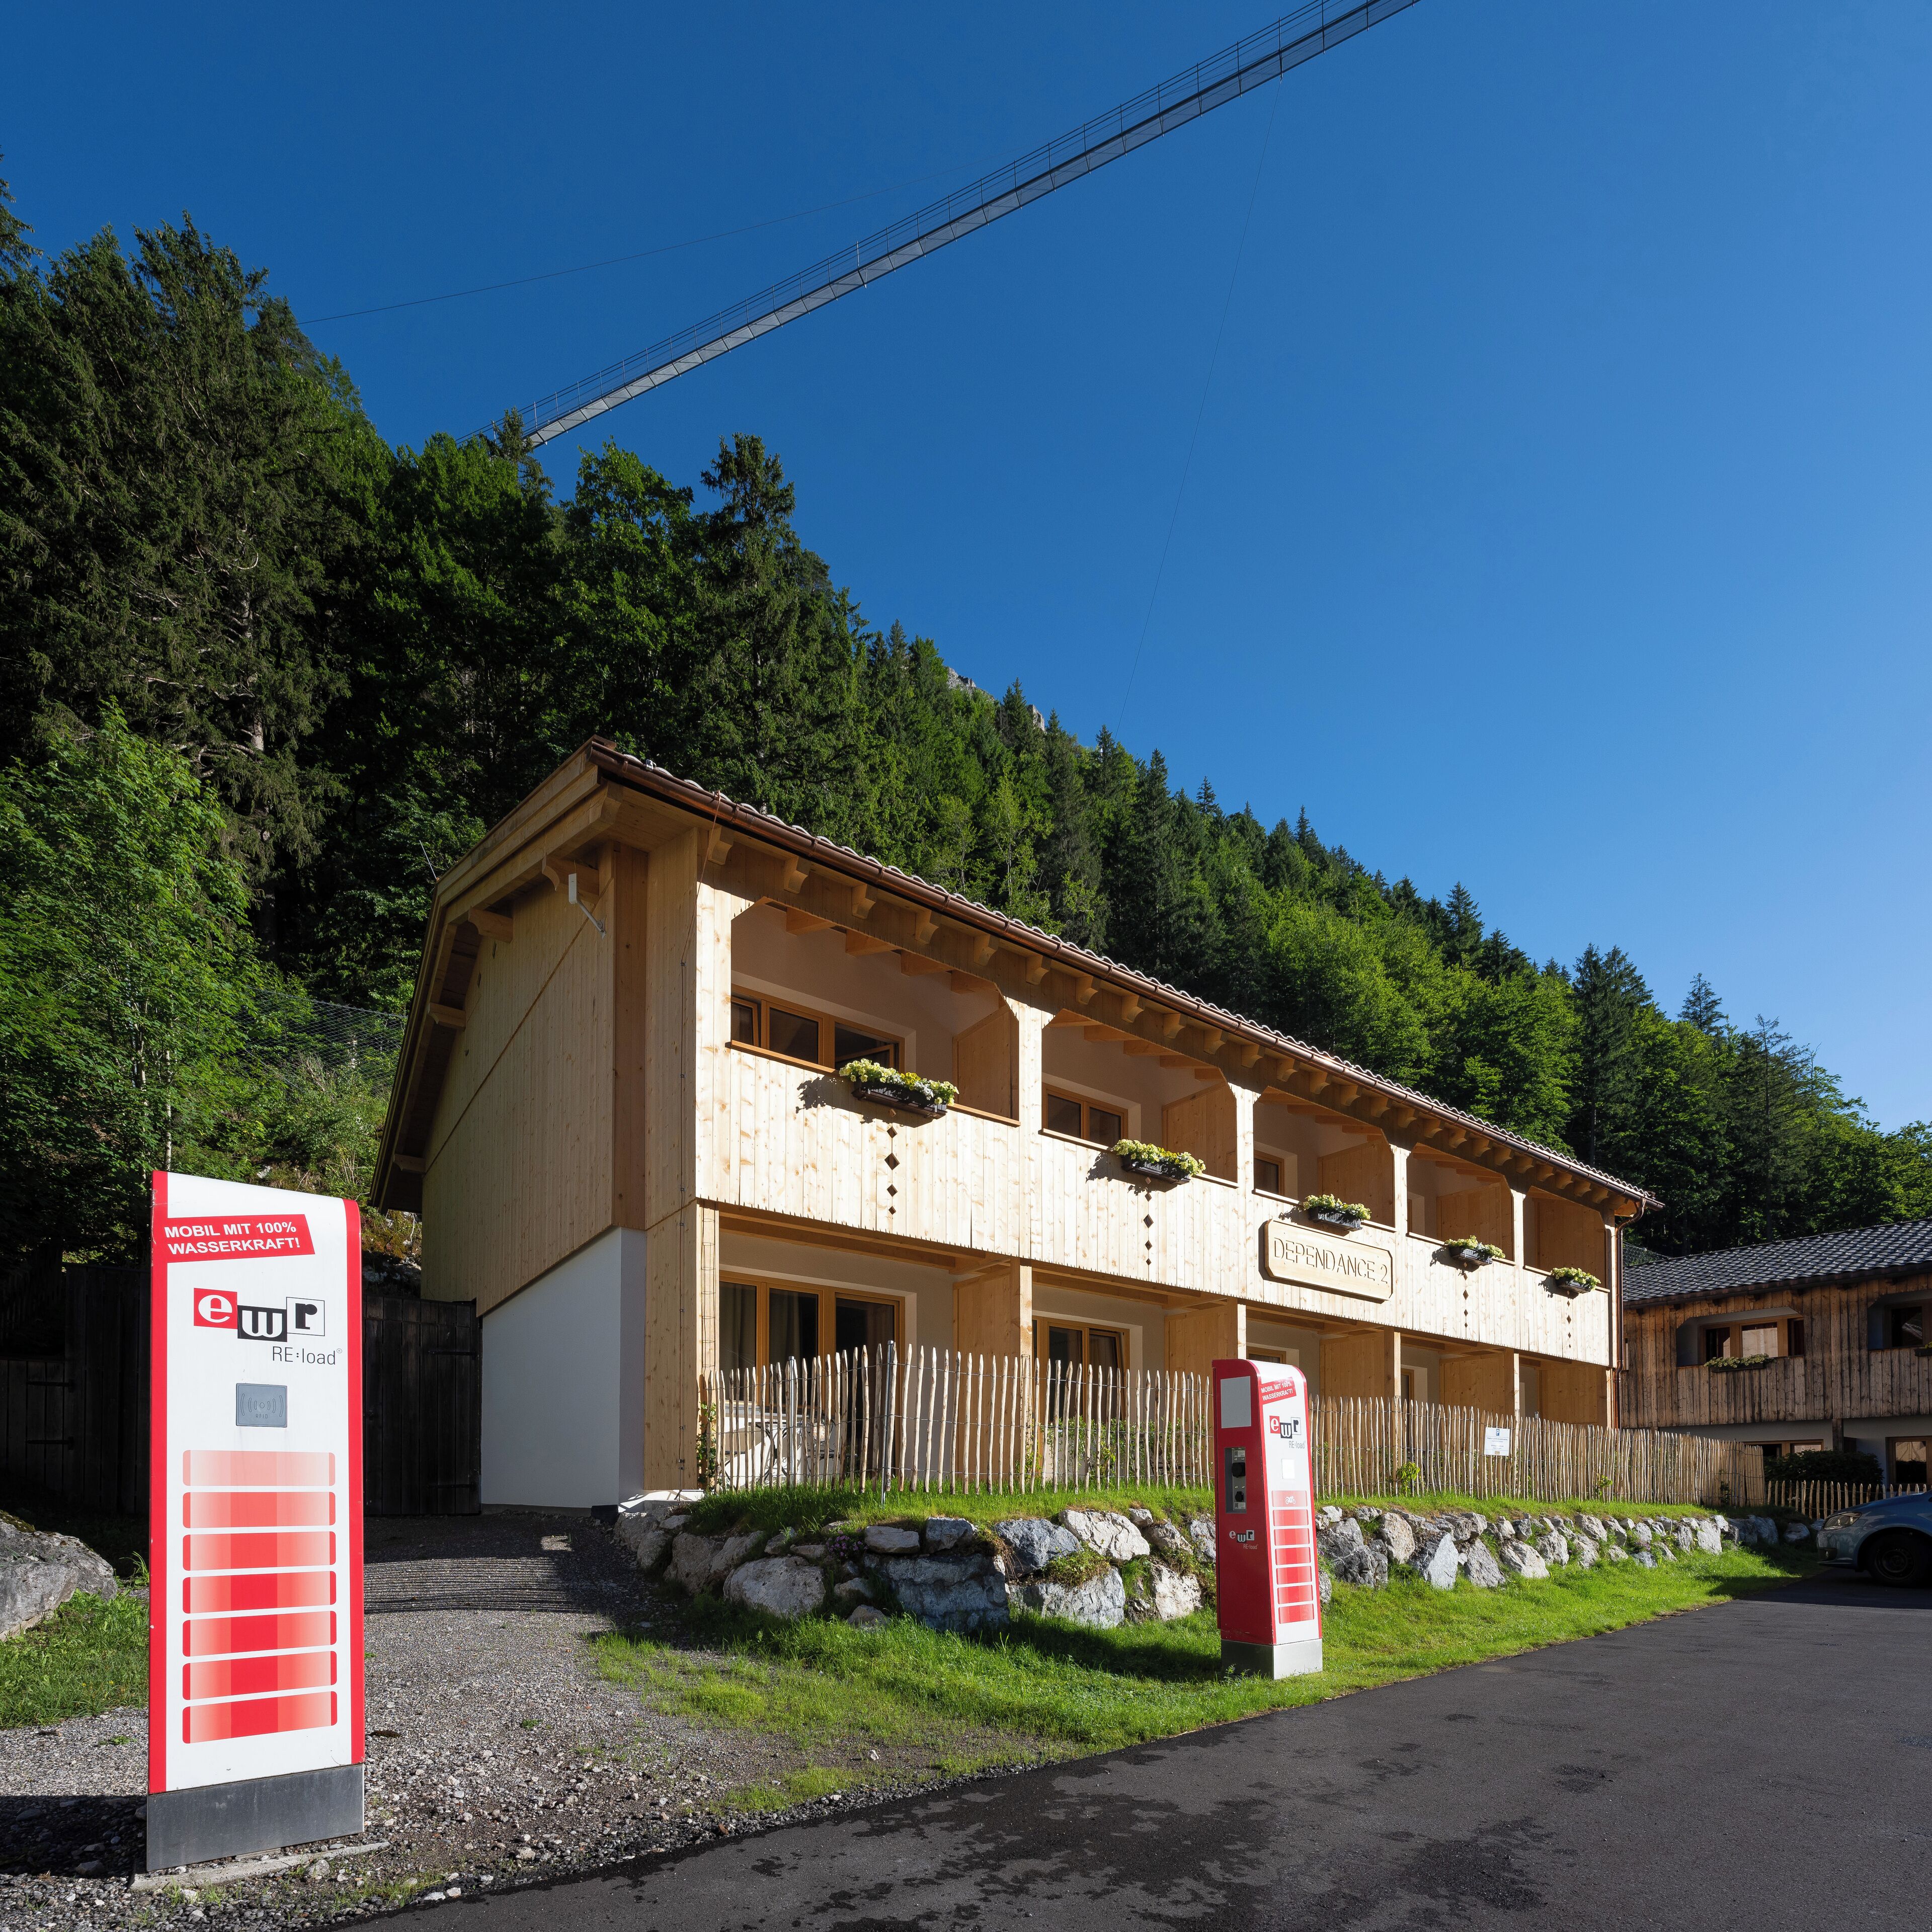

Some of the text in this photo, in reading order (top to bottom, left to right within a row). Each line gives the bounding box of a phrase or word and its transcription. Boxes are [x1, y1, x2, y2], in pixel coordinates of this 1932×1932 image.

[164, 1222, 297, 1238] MOBIL MIT 100%
[168, 1237, 300, 1255] WASSERKRAFT!
[1274, 1237, 1388, 1284] DEPENDANCE 2
[198, 1294, 318, 1338] ewr
[1262, 1388, 1293, 1401] WASSERKRAFT!
[1270, 1418, 1299, 1437] ewr
[1229, 1530, 1253, 1542] ewr
